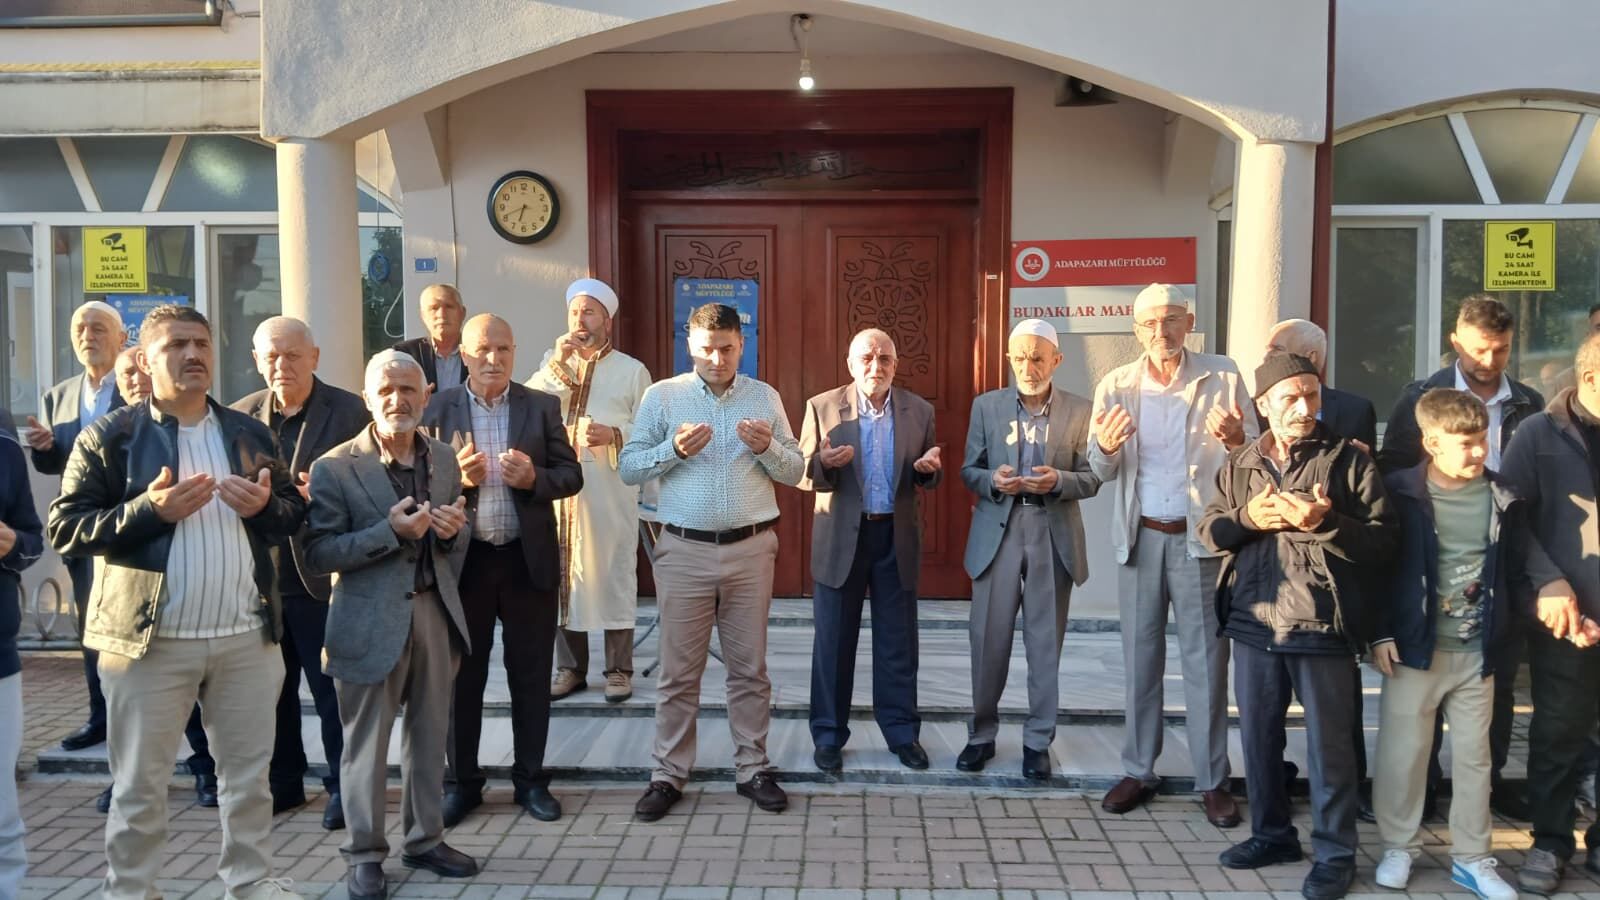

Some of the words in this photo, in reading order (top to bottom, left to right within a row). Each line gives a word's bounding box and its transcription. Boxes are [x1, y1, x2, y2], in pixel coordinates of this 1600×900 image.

[510, 185, 517, 193] 11
[520, 183, 528, 191] 12
[539, 194, 545, 202] 2
[543, 205, 549, 213] 3
[521, 225, 527, 233] 6
[531, 223, 537, 231] 5
[1055, 259, 1108, 269] ADAPAZARI
[1013, 306, 1095, 319] BUDAKLAR
